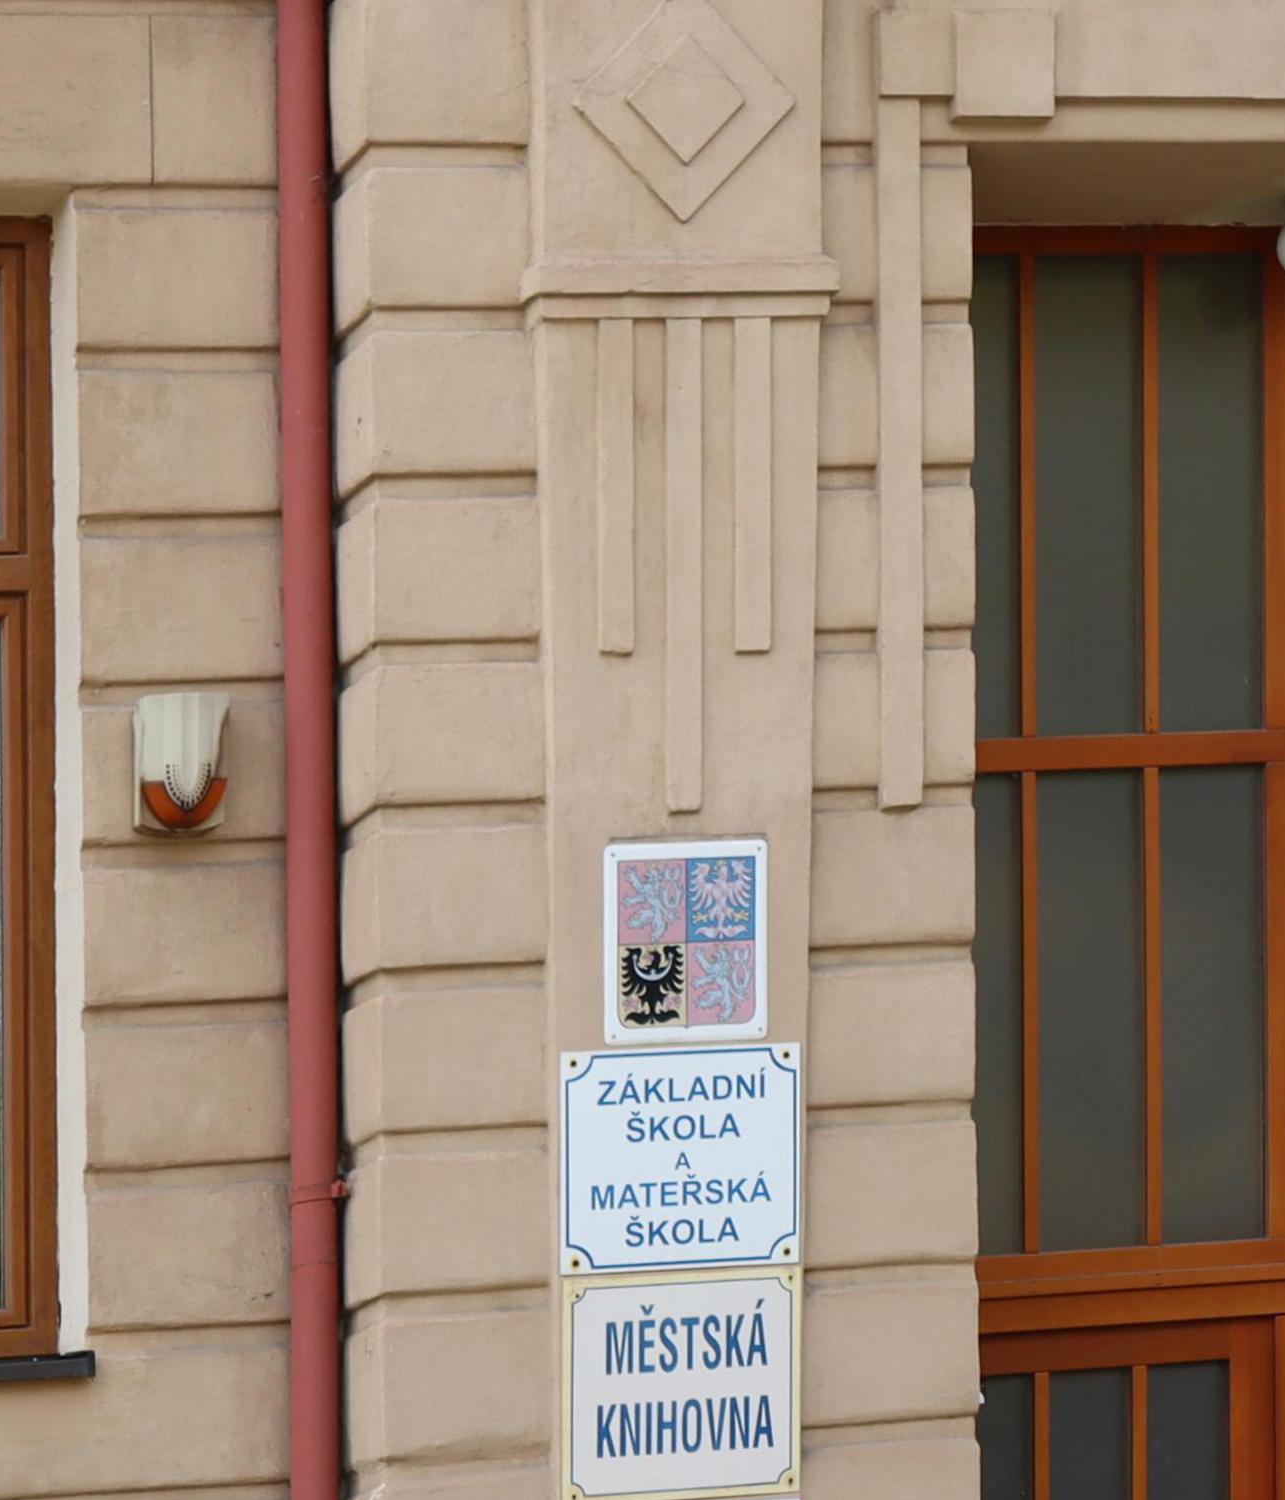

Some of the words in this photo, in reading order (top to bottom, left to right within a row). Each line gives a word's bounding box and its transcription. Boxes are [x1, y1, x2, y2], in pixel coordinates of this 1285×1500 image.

[597, 1067, 766, 1105] ZÁKLADNÍ
[626, 1111, 740, 1143] ŠKOLA
[675, 1152, 691, 1170] A
[591, 1171, 772, 1210] MATEŘSKÁ
[625, 1215, 739, 1247] ŠKOLA
[605, 1298, 767, 1376] MĚSTSKÁ
[596, 1395, 774, 1458] KNIHOVNA
